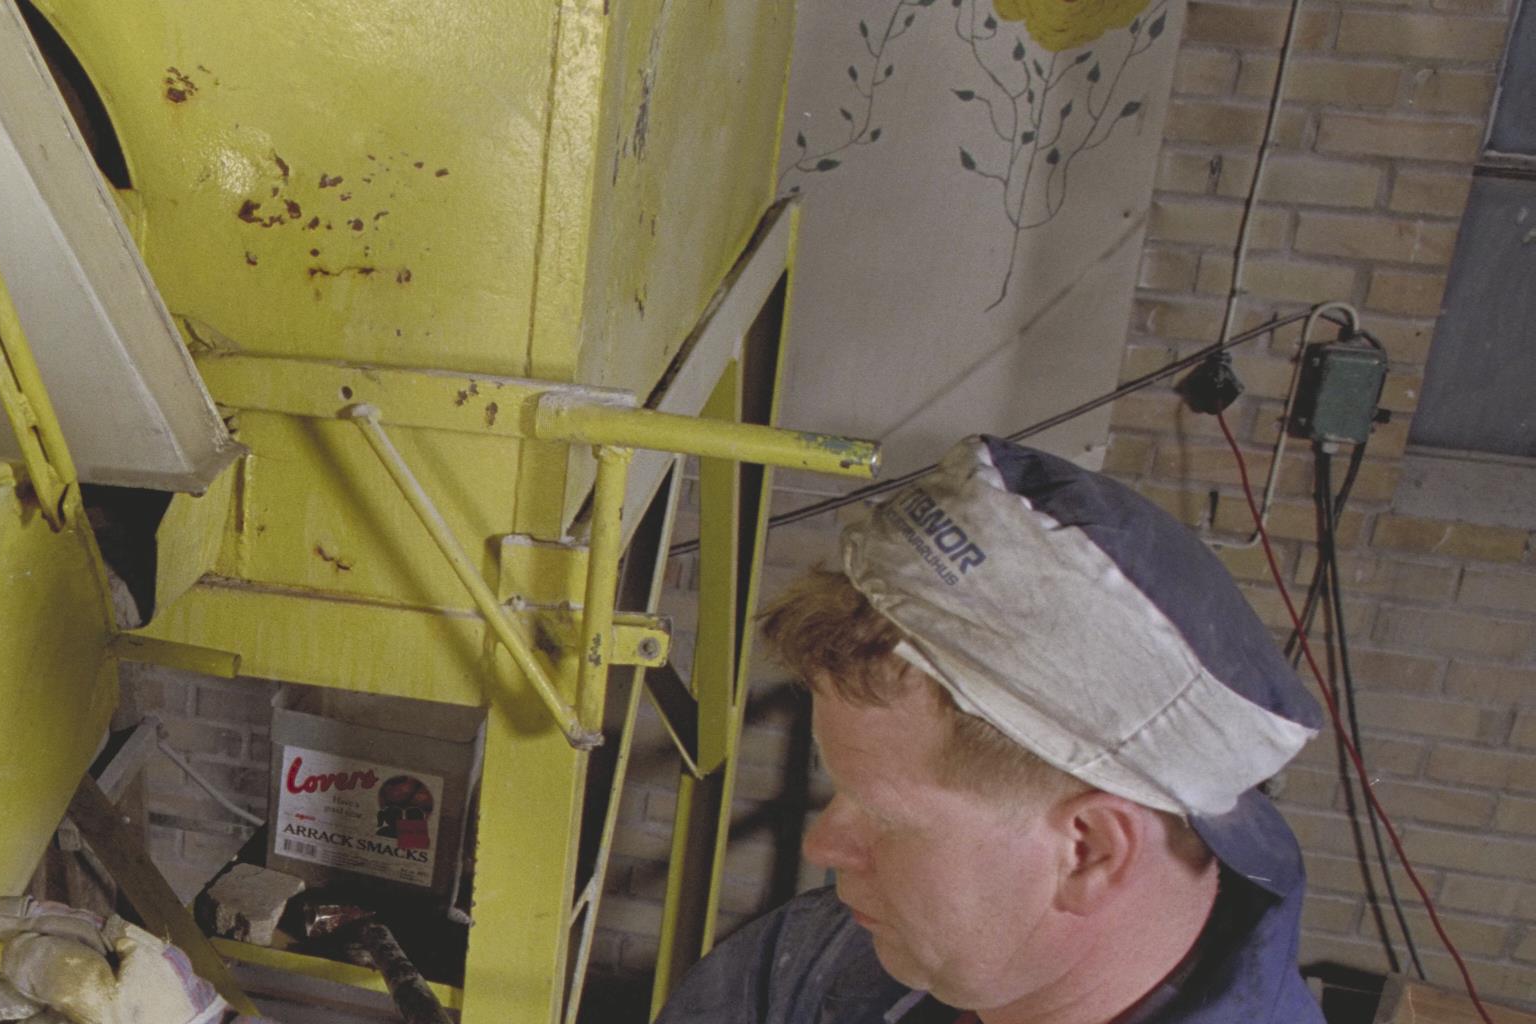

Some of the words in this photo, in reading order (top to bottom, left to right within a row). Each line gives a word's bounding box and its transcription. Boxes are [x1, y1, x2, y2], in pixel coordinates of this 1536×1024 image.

[286, 756, 379, 794] Lovers
[283, 823, 353, 848] ARRACK
[357, 839, 429, 863] SMACKS
